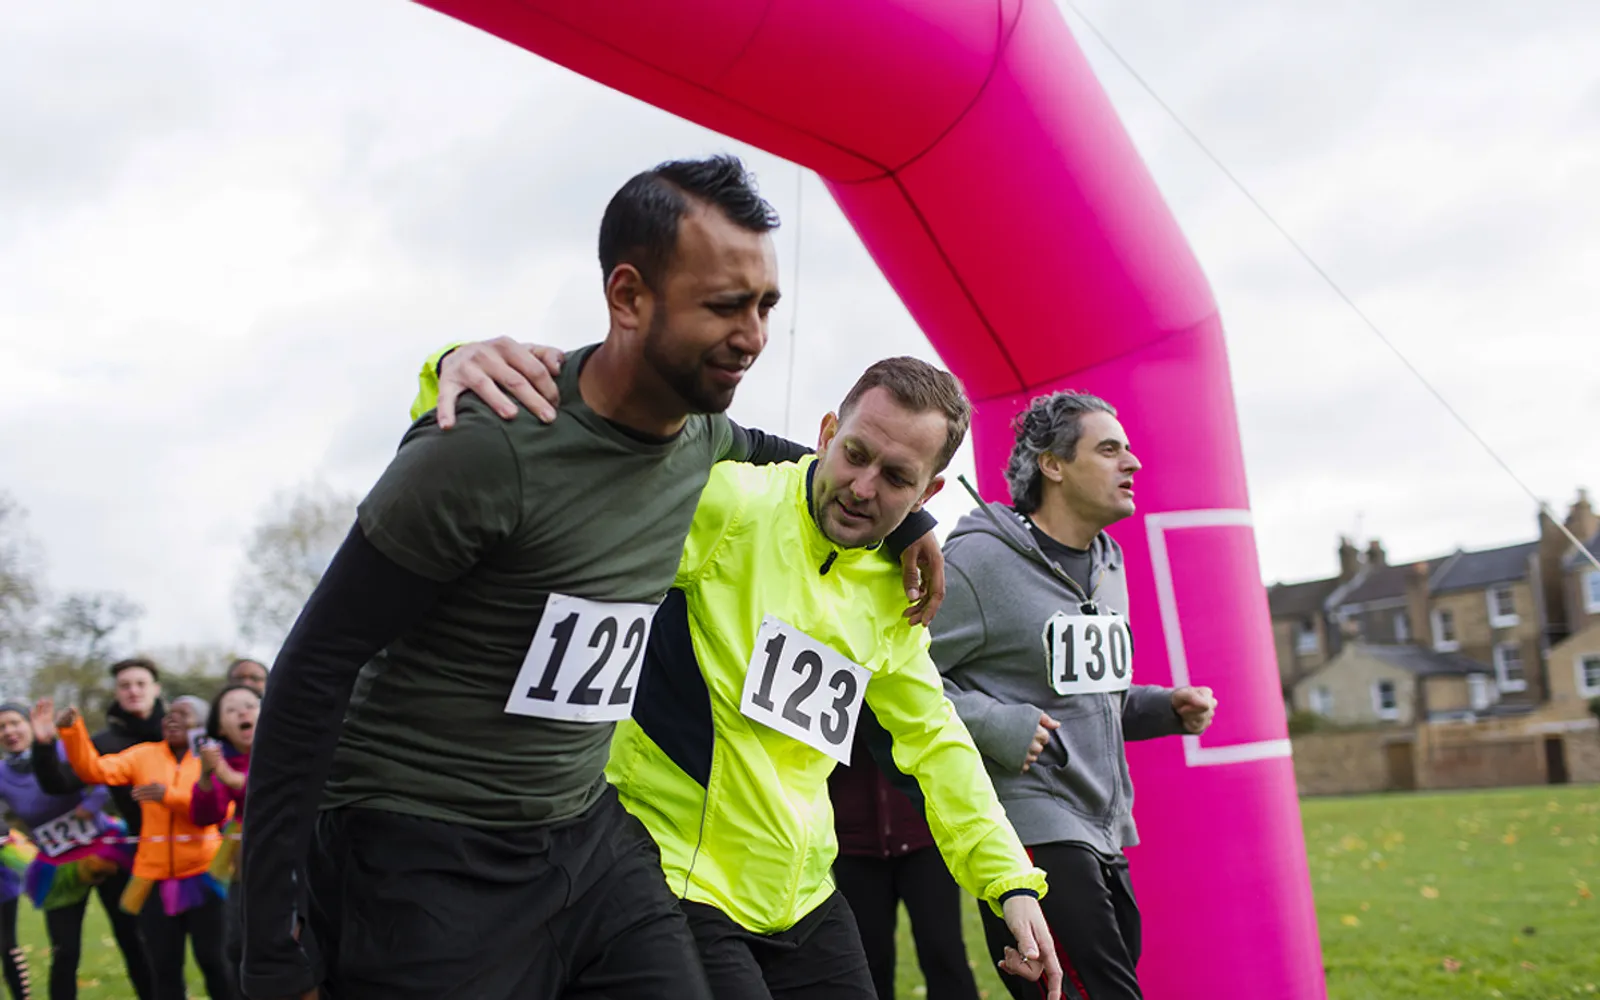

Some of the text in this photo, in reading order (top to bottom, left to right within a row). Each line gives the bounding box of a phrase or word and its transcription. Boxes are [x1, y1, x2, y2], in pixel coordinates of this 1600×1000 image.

[526, 612, 646, 705] 122
[751, 633, 857, 745] 123
[1060, 623, 1126, 682] 130
